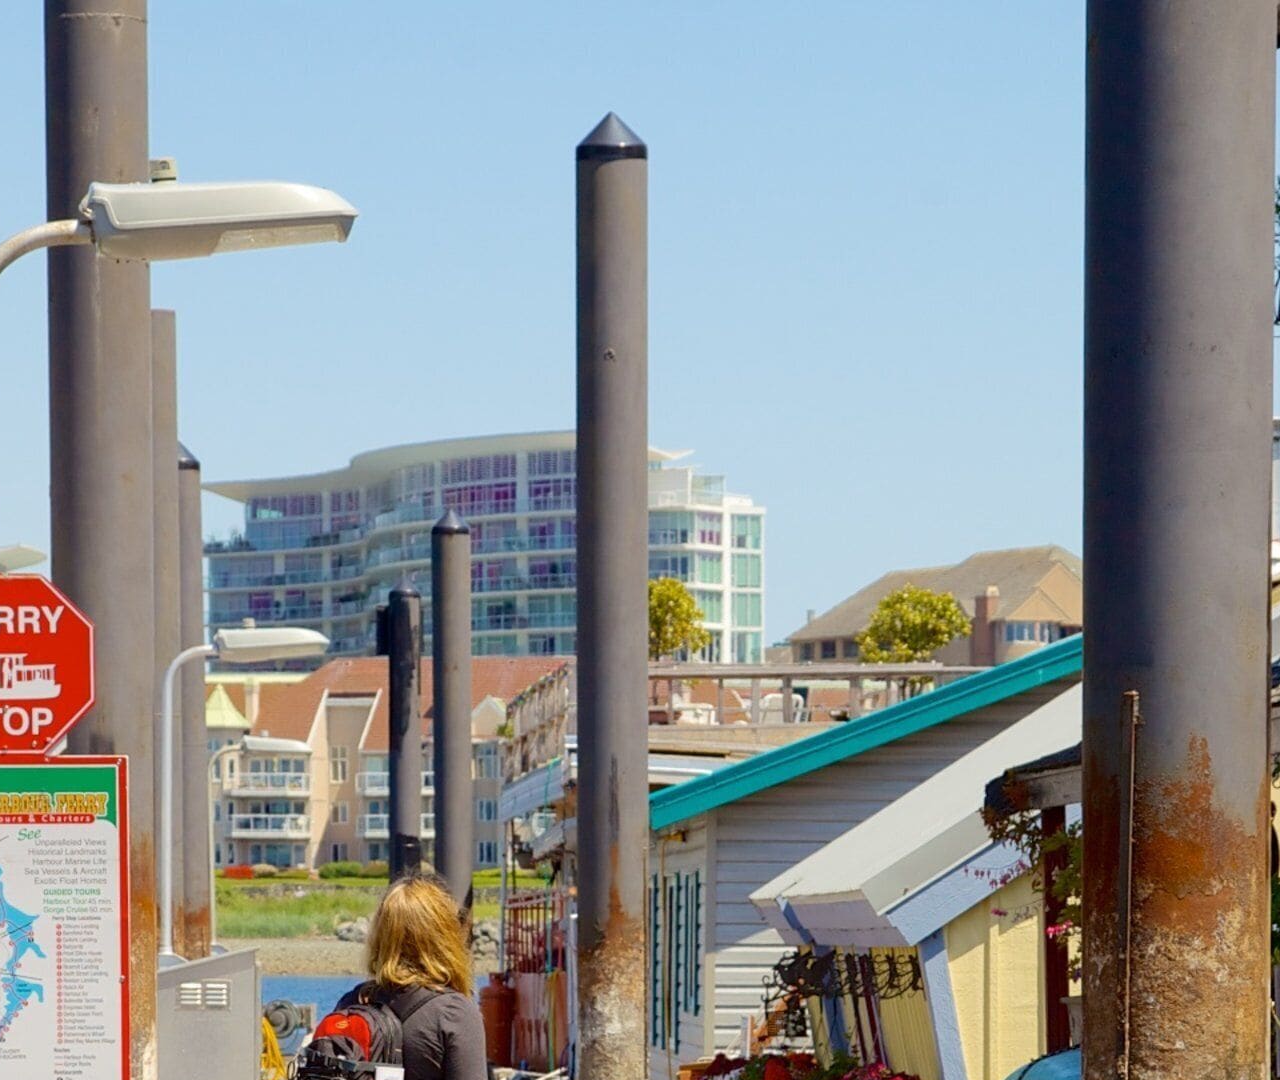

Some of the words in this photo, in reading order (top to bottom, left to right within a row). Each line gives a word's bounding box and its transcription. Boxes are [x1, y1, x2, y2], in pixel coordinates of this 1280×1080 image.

[55, 792, 109, 816] FERRY
[28, 815, 37, 823] &
[41, 814, 92, 823] Charters
[17, 828, 42, 841] See
[94, 857, 107, 865] Life
[34, 877, 58, 885] Exotic
[43, 906, 65, 914] Gorge
